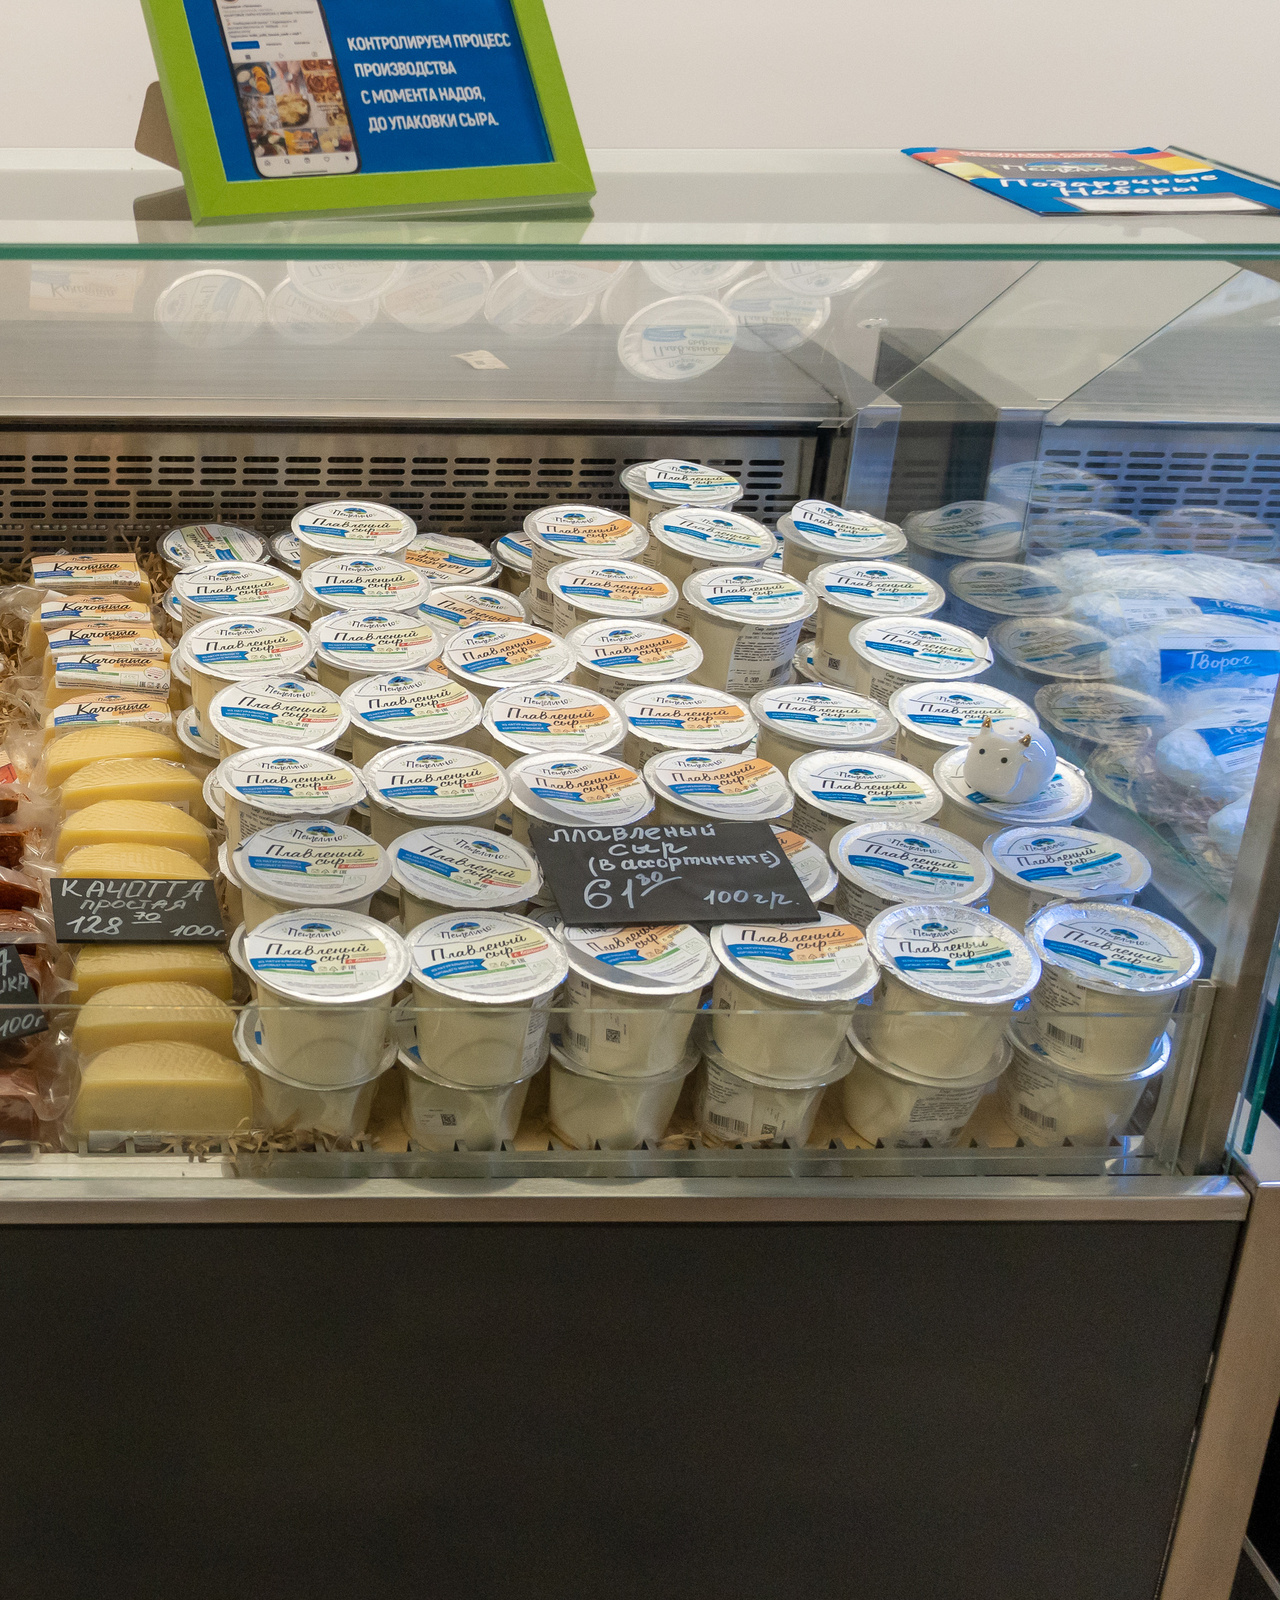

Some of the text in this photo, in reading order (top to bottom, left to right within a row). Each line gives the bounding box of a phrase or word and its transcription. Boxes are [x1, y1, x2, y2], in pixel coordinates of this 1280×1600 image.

[347, 32, 511, 52] КОНТРОЛИРУЕМ ПРОЦЕСС
[354, 61, 457, 79] ПРОИЗВОДСТВА
[361, 86, 486, 104] С МОМЕНТА НАДОЯ,
[369, 111, 499, 134] ДО УПАКОВКИ СЫРА.
[999, 174, 1218, 189] Подарочные
[1061, 186, 1198, 197] Наборы
[312, 517, 391, 529] Плавленый
[547, 525, 619, 534] Плавленый
[680, 521, 751, 540] Плавленый
[326, 575, 405, 586] Плавленый
[368, 582, 392, 590] сыр
[573, 578, 654, 592] Плавленый
[838, 577, 913, 589] Плавленый
[197, 581, 274, 594] Плавленый
[615, 588, 639, 596] сыр
[714, 584, 784, 595] Плавленый
[334, 631, 418, 641] Плавленый
[206, 638, 288, 651] Плавленый
[250, 645, 274, 653] сыр
[462, 638, 536, 661] Плавленый
[595, 639, 672, 657] Плавленый
[882, 634, 963, 653] Плавленый
[506, 647, 527, 657] сыр
[639, 647, 662, 656] сыр
[1186, 651, 1253, 671] Творог
[238, 696, 327, 713] Плавленый
[369, 690, 451, 708] Плавленый
[415, 700, 438, 708] сыр
[507, 708, 594, 720] Плавленый
[641, 708, 729, 717] Плавленый
[778, 703, 860, 714] Плавленый
[920, 703, 1003, 714] Плавленый
[282, 711, 309, 721] сыр
[553, 720, 579, 728] сыр
[392, 769, 482, 785] Плавленый
[672, 764, 755, 782] Плавленый
[247, 775, 336, 784] Плавленый
[440, 779, 466, 787] сыр
[536, 773, 620, 789] Плавленый
[720, 776, 745, 785] сыр
[822, 780, 907, 790] Плавленый
[295, 782, 320, 790] сыр
[583, 783, 608, 793] сыр
[266, 844, 364, 858] Плавленый
[609, 844, 688, 858] сыр
[865, 844, 958, 869] Плавленый
[1017, 847, 1096, 867] Плавленый
[315, 857, 344, 868] сыр
[420, 846, 515, 879] Плавленый
[911, 862, 939, 873] сыр
[1064, 858, 1087, 867] сыр
[463, 868, 492, 881] сыр
[61, 879, 206, 901] КАЧОТТА
[583, 878, 635, 909] 61
[67, 916, 123, 935] 128
[131, 912, 162, 924] 70
[635, 933, 658, 949] сыр
[742, 929, 845, 943] Плавленый
[265, 943, 369, 956] Плавленый
[431, 934, 526, 961] Плавленый
[797, 941, 827, 951] сыр
[899, 941, 988, 953] Плавленый
[1064, 930, 1163, 963] Плавленый
[320, 954, 350, 964] сыр
[485, 948, 514, 959] сыр
[949, 950, 975, 959] сыр
[1111, 953, 1142, 965] сыр
